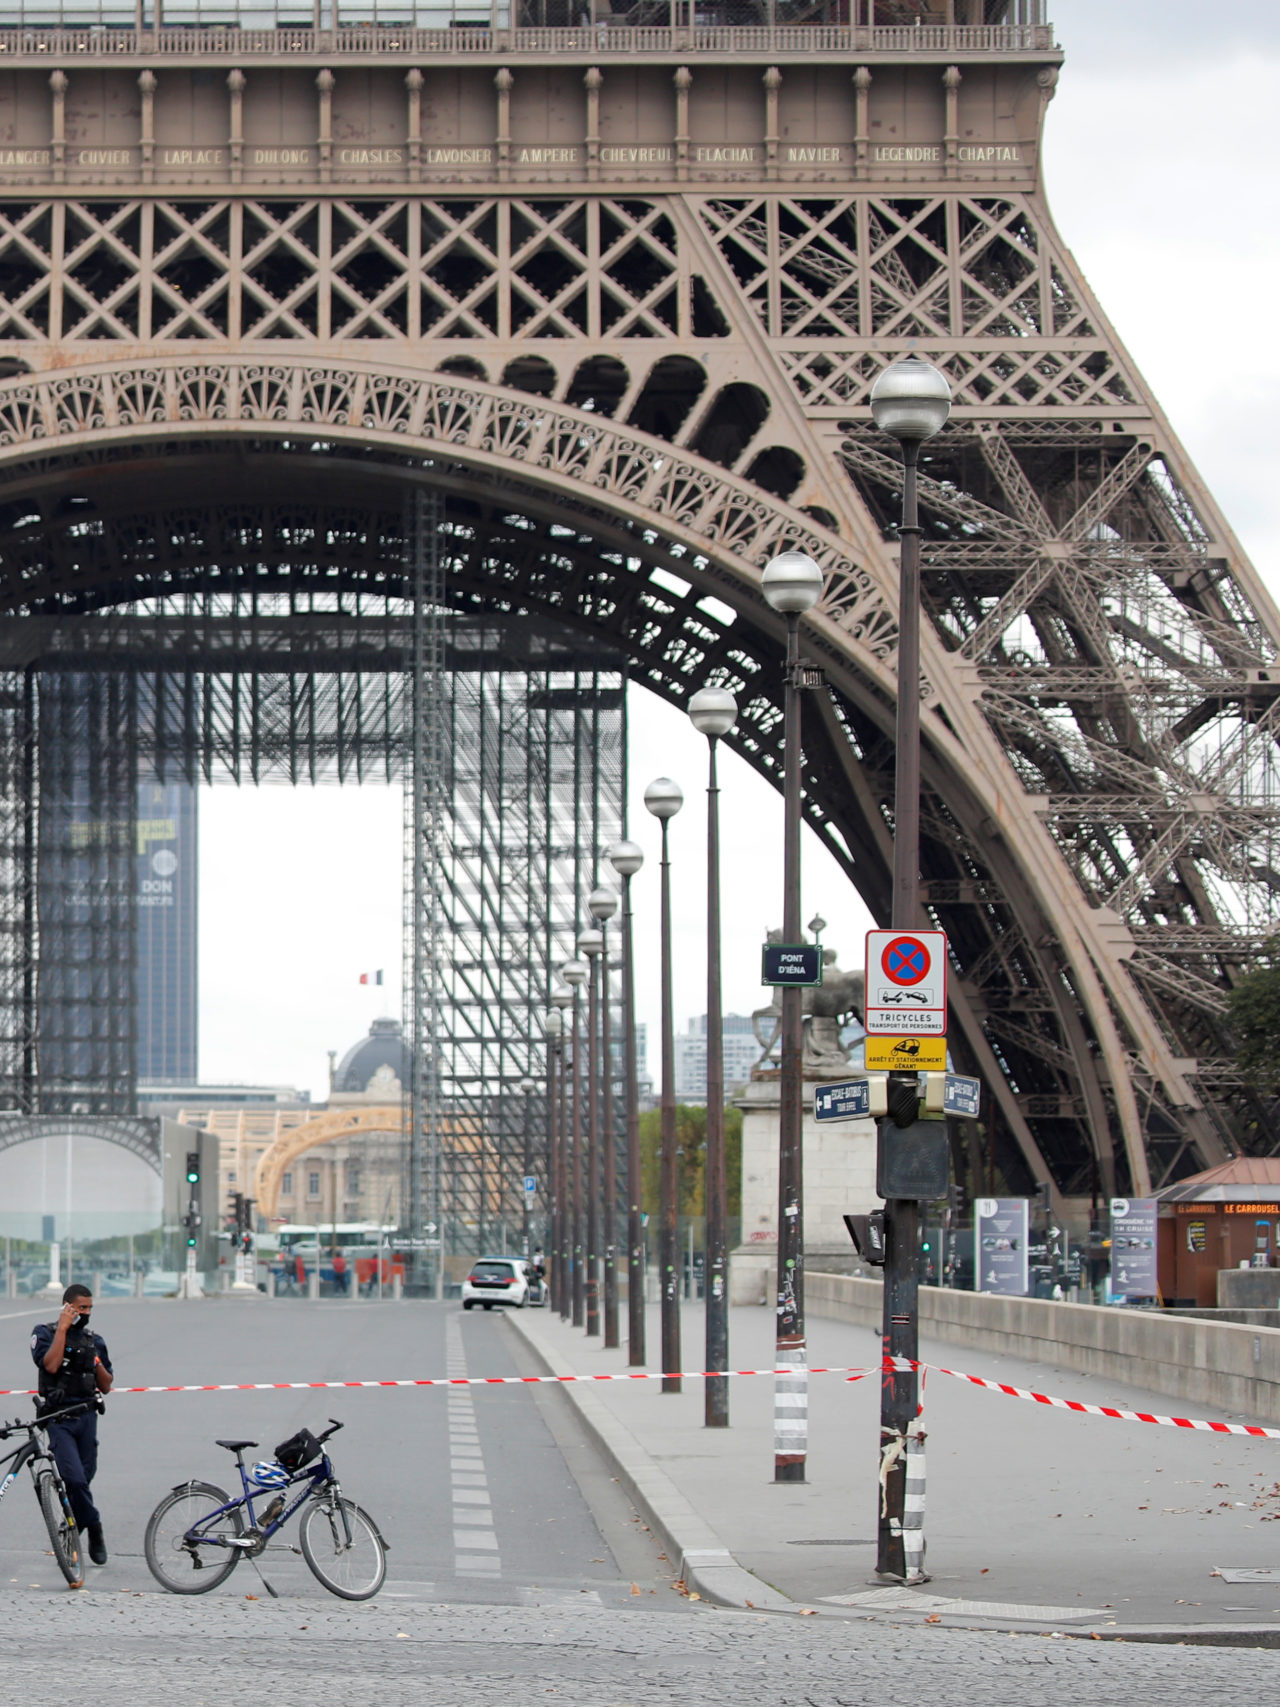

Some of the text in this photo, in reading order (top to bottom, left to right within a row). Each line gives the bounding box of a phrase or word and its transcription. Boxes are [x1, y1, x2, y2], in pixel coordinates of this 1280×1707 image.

[78, 150, 130, 164] CUVIER
[164, 150, 222, 164] LAPLACE
[255, 150, 309, 164] DULONG
[340, 149, 402, 163] CHASLES
[426, 149, 492, 163] LAVOISIER
[521, 148, 577, 162] AMPERE
[600, 148, 673, 162] CHEVREUL
[696, 147, 755, 162] FLACHAT
[788, 147, 840, 161] NAVIER
[875, 147, 940, 161] LEGENDRE
[959, 147, 1020, 161] CHAPTAL
[780, 954, 804, 962] PONT
[777, 964, 806, 974] D'IÉNA
[880, 1014, 932, 1022] TRICYCLES
[1224, 1204, 1280, 1214] LE CARROUSEL
